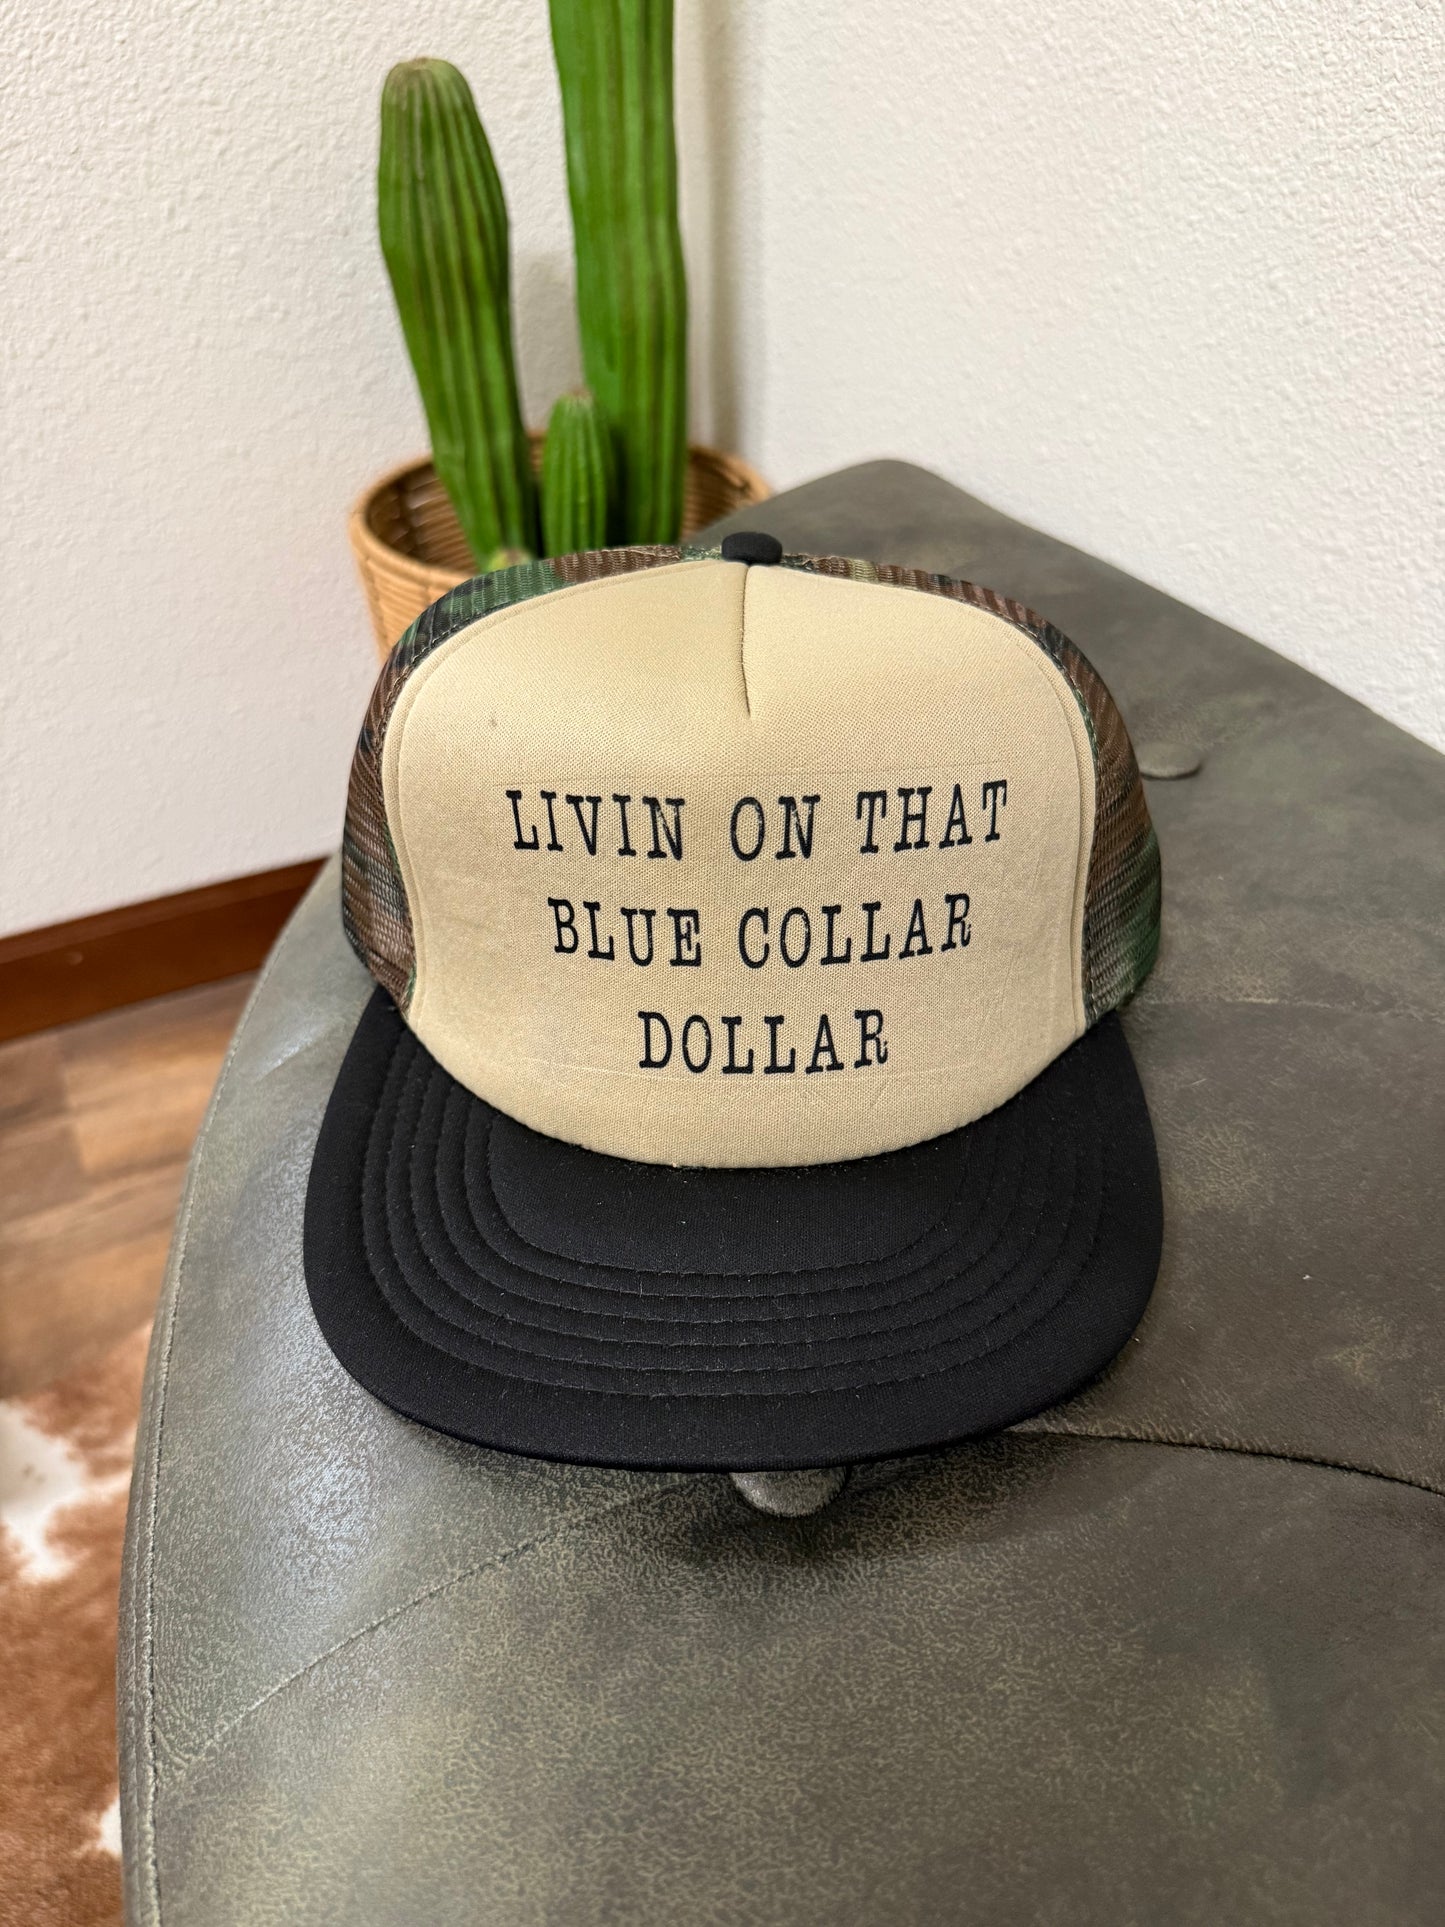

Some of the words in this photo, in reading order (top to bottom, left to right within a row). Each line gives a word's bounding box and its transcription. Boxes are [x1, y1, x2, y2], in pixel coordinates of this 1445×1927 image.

[505, 788, 687, 862] LIVIN
[729, 794, 822, 863] ON
[855, 778, 1009, 857] THAT
[546, 896, 703, 968] BLUE
[737, 892, 972, 970] COLLAR
[636, 1009, 889, 1076] DOLLAR
